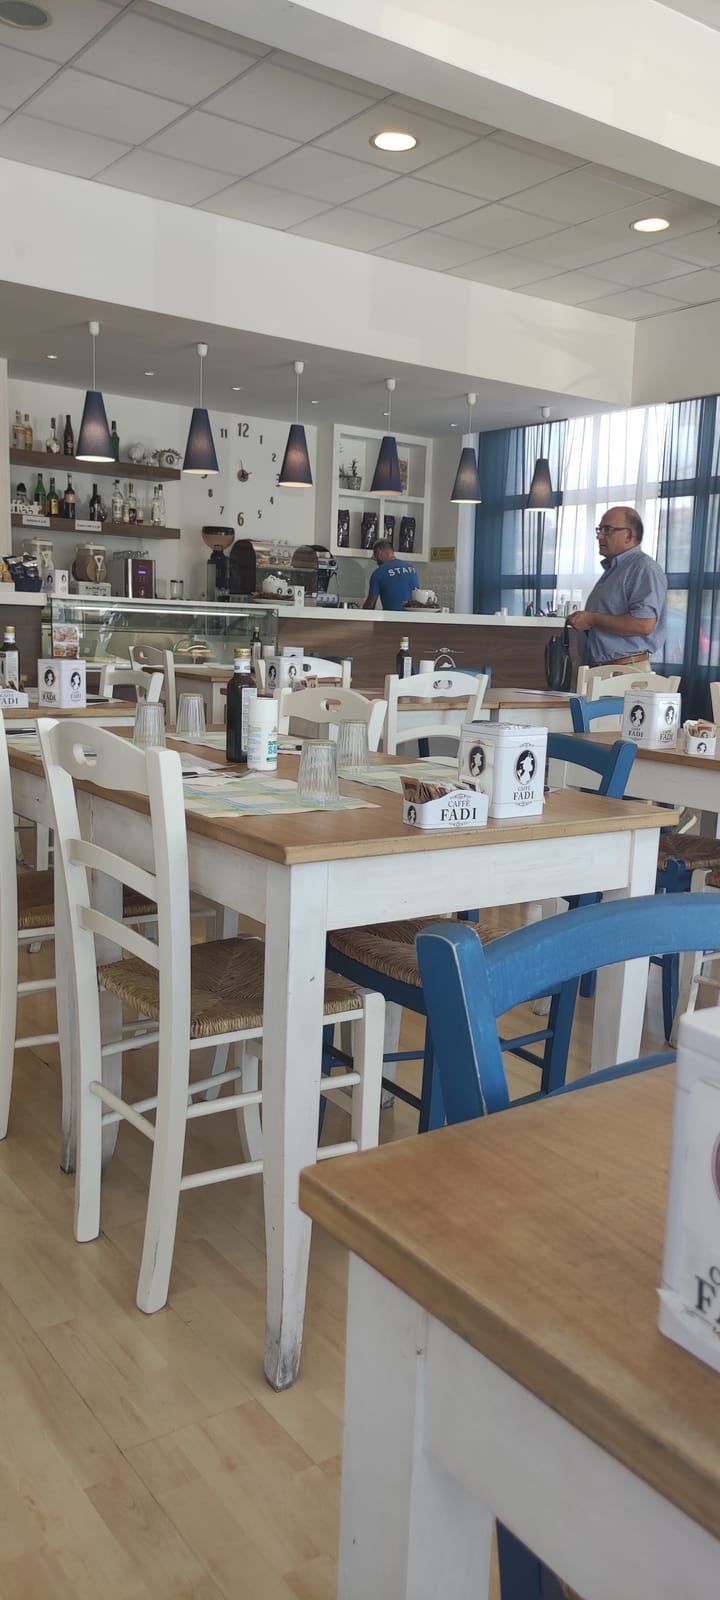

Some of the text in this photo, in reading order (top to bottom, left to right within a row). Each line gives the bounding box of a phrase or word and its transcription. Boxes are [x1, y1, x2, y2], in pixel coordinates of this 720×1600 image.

[220, 428, 228, 438] 11
[237, 422, 249, 438] 12
[260, 435, 263, 444] 1
[272, 453, 276, 462] 2
[208, 488, 213, 498] 8
[269, 496, 274, 505] 4
[10, 500, 33, 515] ffee
[220, 506, 224, 515] 7
[237, 512, 244, 526] 6
[257, 510, 262, 519] 5
[513, 791, 534, 801] FADI
[440, 808, 476, 821] FADI
